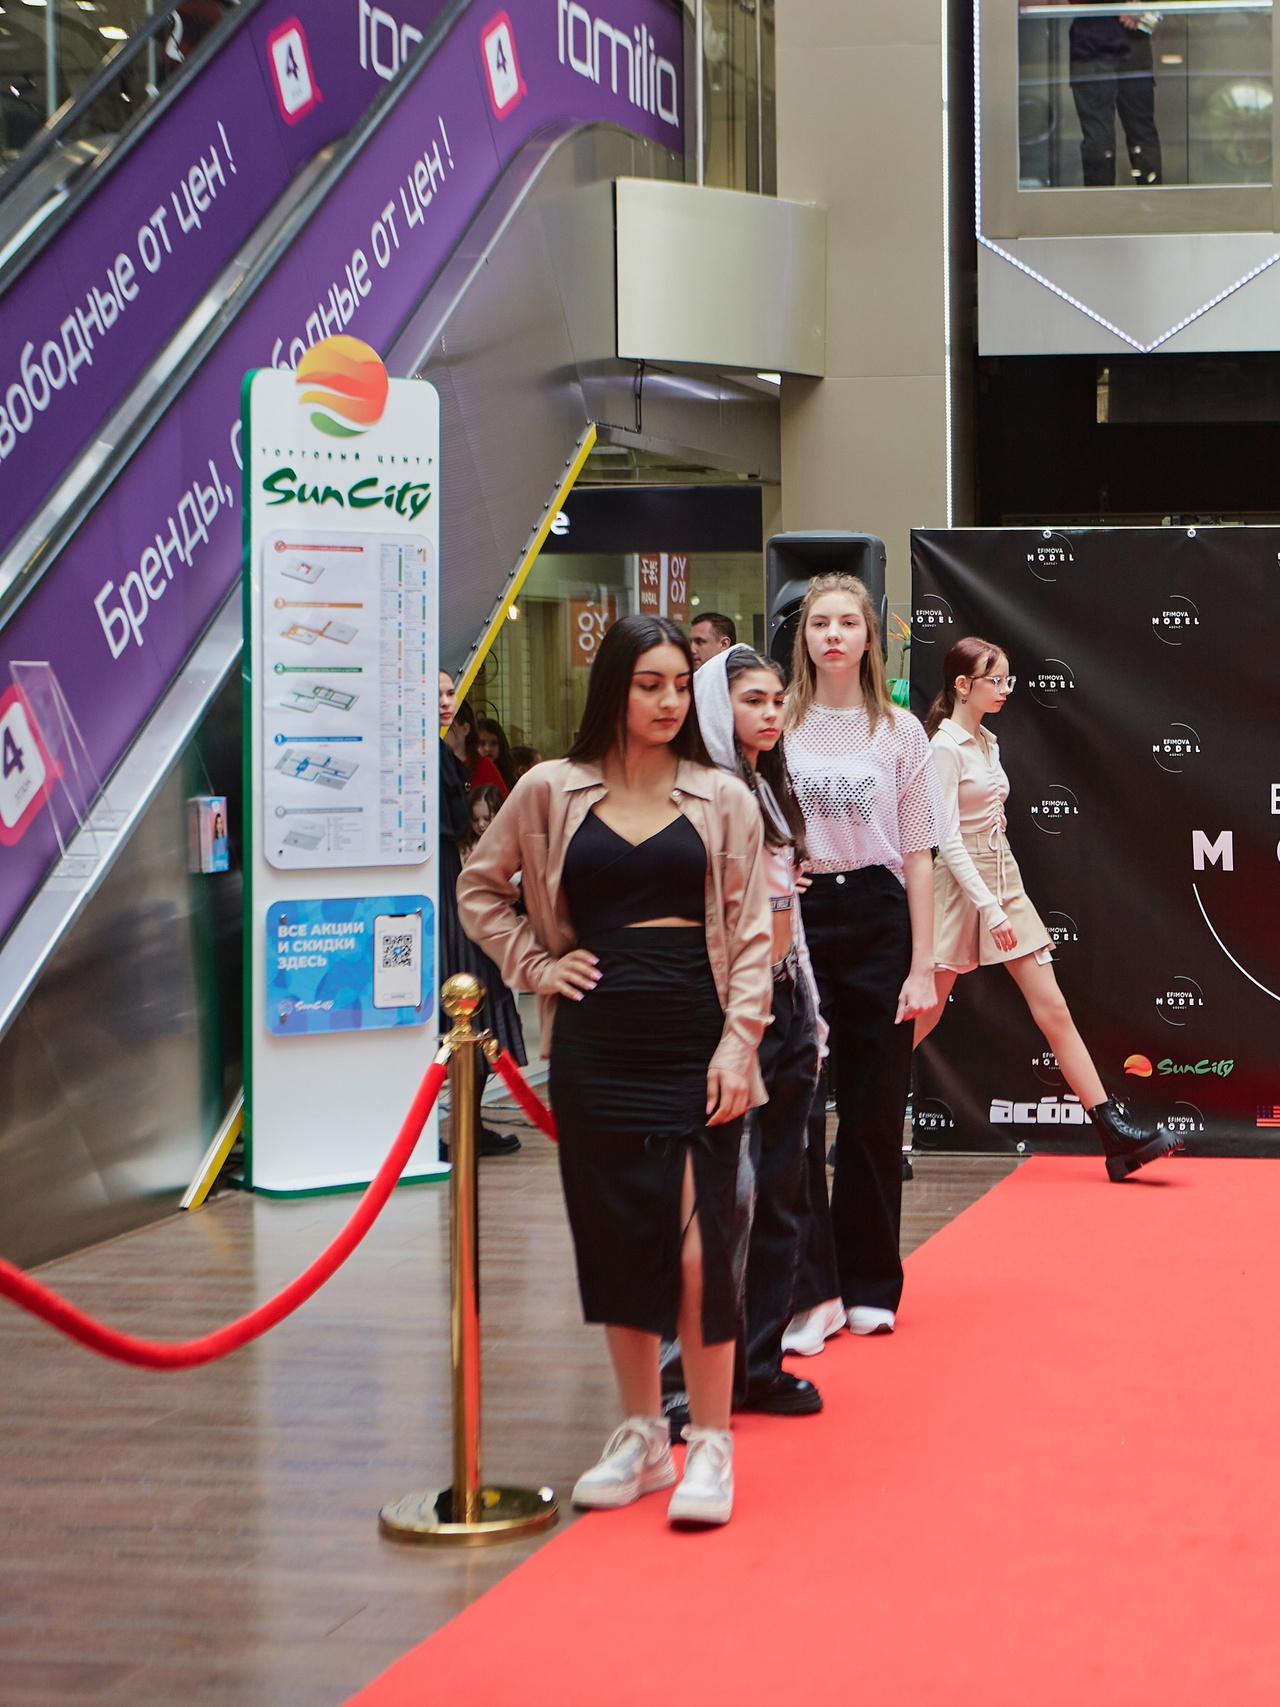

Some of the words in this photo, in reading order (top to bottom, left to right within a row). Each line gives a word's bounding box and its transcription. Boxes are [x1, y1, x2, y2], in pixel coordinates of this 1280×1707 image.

[138, 205, 172, 273] от
[371, 200, 400, 269] от
[377, 454, 432, 465] ЦЕНТР
[262, 467, 432, 522] SunCity
[94, 458, 234, 660] Бренды,
[3, 726, 25, 779] 4
[277, 924, 307, 938] ВСЕ
[311, 922, 364, 936] АКЦИИ
[277, 941, 289, 953] И
[292, 937, 355, 952] СКИДКИ
[277, 955, 328, 970] ЗДЕСЬ
[1157, 1058, 1234, 1078] SunCity
